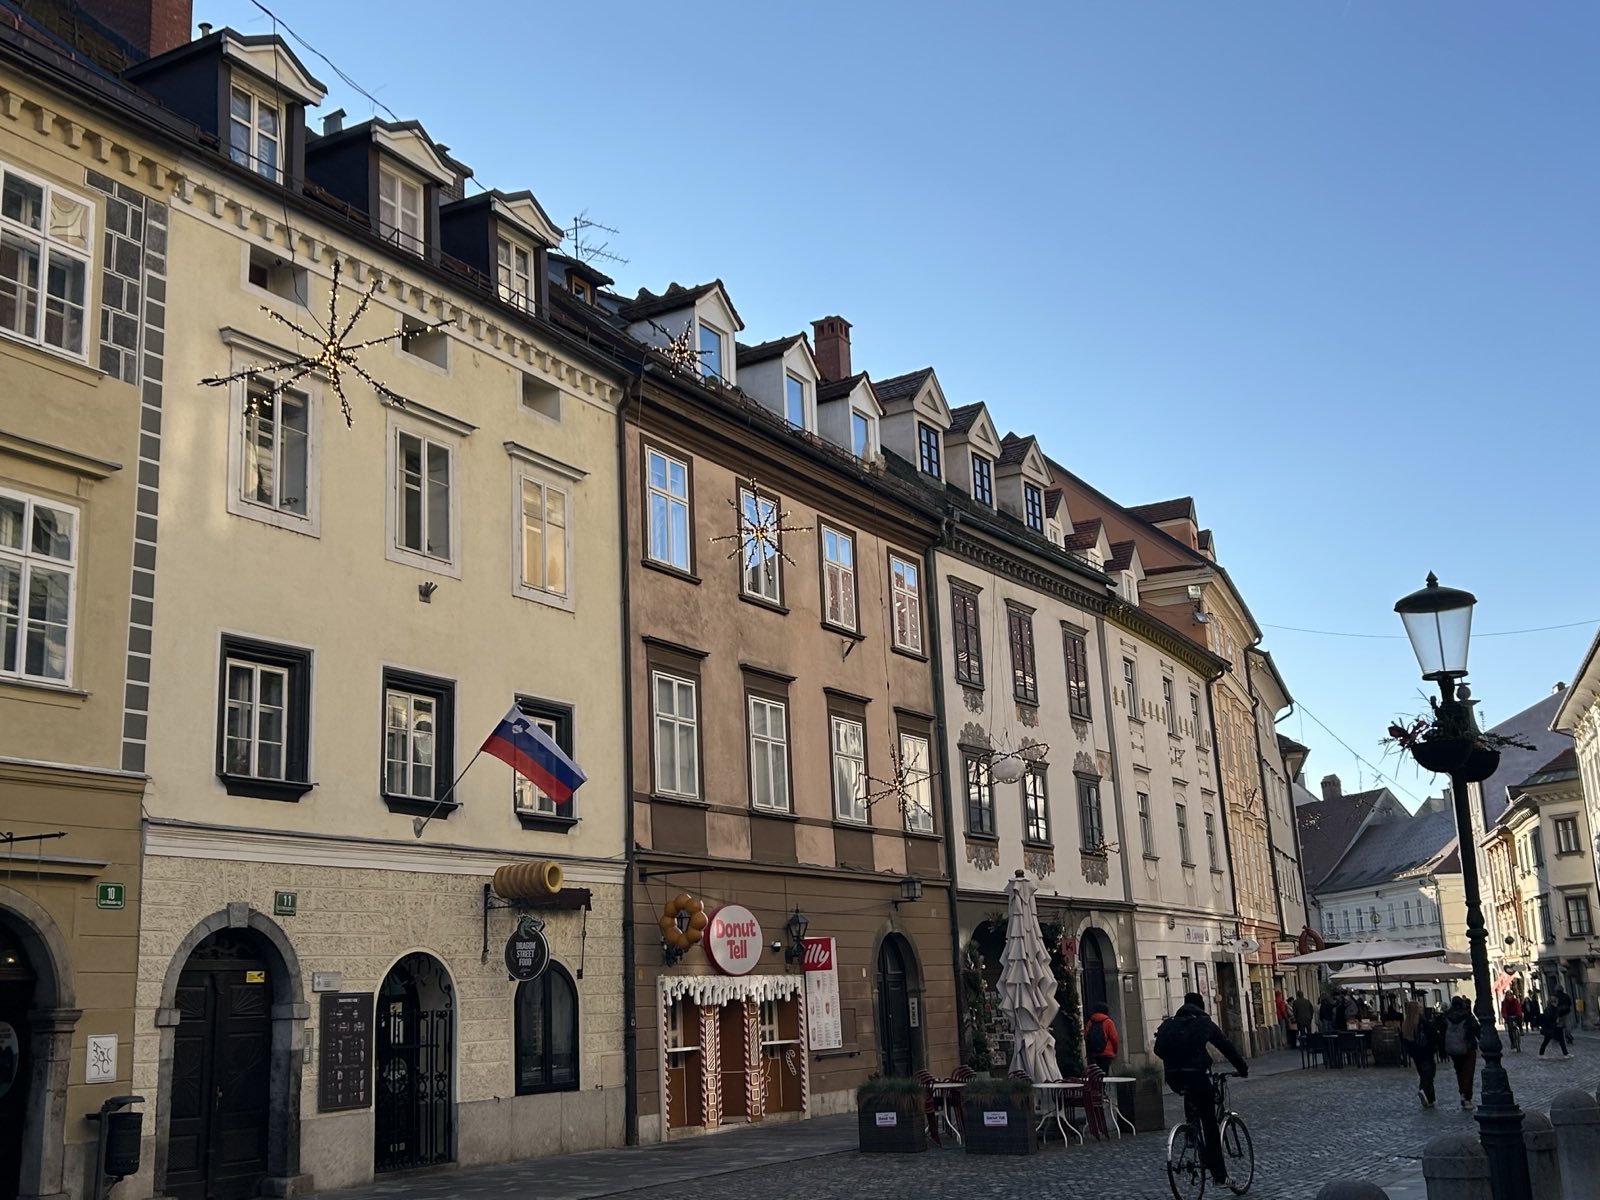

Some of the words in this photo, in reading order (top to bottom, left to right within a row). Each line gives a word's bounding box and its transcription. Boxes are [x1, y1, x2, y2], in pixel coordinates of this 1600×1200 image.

[107, 887, 115, 900] 10
[283, 895, 292, 906] 11
[716, 919, 756, 938] Donut
[515, 941, 536, 950] DRAGON
[727, 939, 747, 959] Tell
[516, 949, 535, 958] STREET
[804, 943, 830, 968] illy
[518, 958, 532, 966] FOOD
